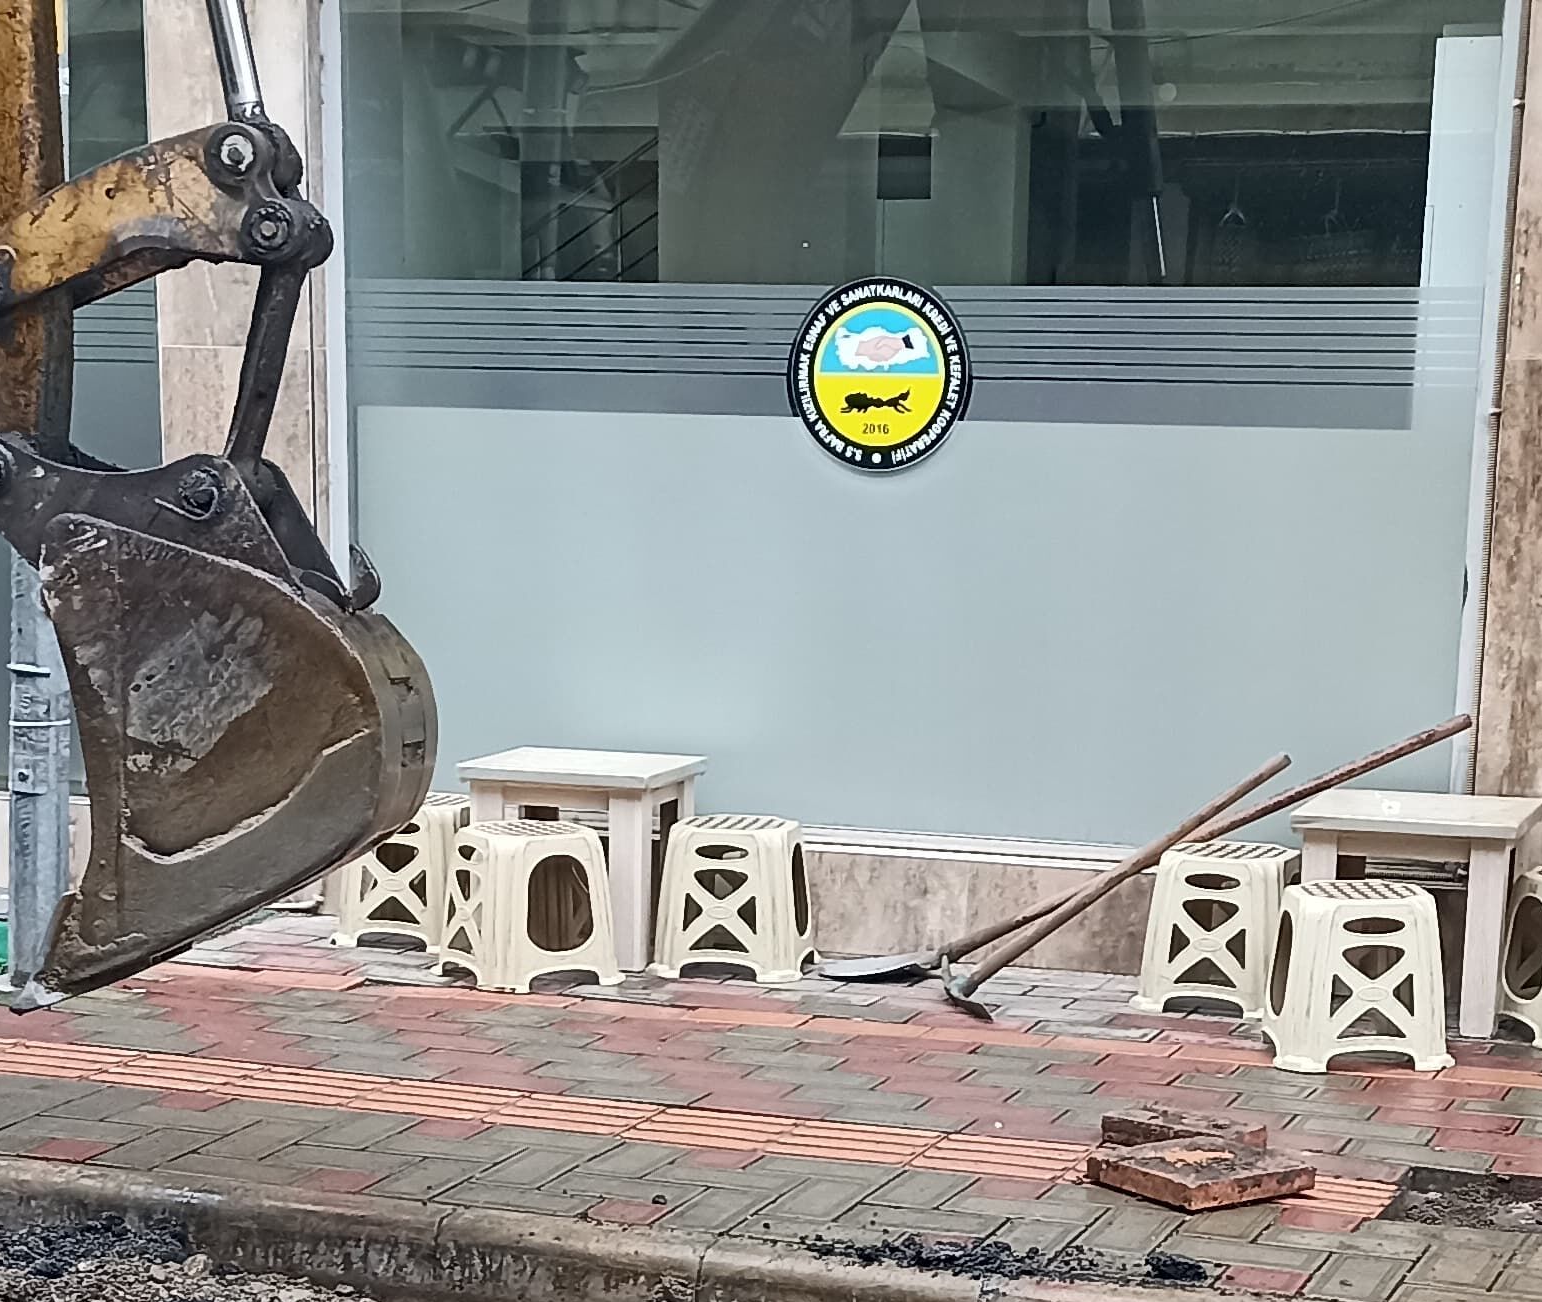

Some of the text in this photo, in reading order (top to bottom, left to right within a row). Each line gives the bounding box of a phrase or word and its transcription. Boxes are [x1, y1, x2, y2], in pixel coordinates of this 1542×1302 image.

[824, 299, 841, 316] VE
[840, 284, 925, 308] SANATKARLARI
[802, 312, 827, 352] ESNAF
[944, 334, 958, 354] VE
[945, 355, 962, 409] KEFALET
[814, 420, 846, 454] BAFRA
[862, 423, 890, 435] 2016
